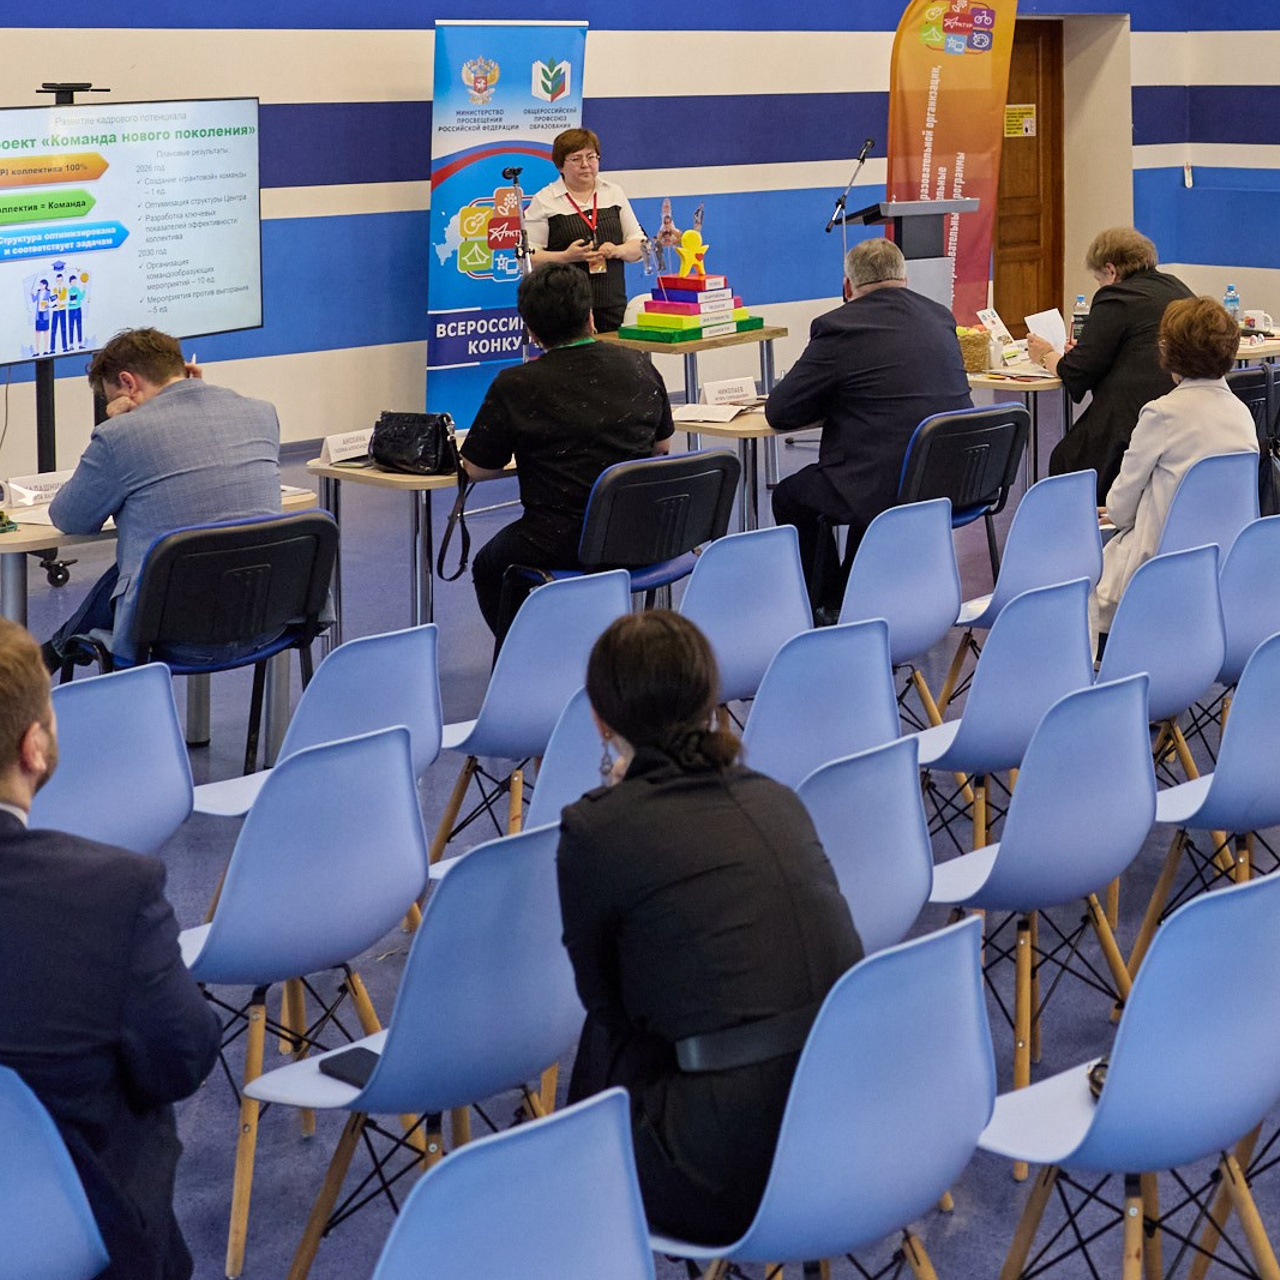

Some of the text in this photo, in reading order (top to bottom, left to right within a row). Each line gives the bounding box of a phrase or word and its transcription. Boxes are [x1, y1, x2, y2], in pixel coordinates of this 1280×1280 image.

[456, 109, 505, 117] МИНИСТЕРСТВО
[0, 125, 256, 150] оект «Команда нового поколения»
[438, 124, 519, 132] РОССИЙСКОЙ ФЕДЕРАЦИИ
[920, 130, 934, 200] разовательной
[953, 152, 966, 200] рограммы
[48, 200, 86, 210] Команда
[436, 316, 524, 338] ВСЕРОССИ
[468, 336, 523, 355] КОНКУ
